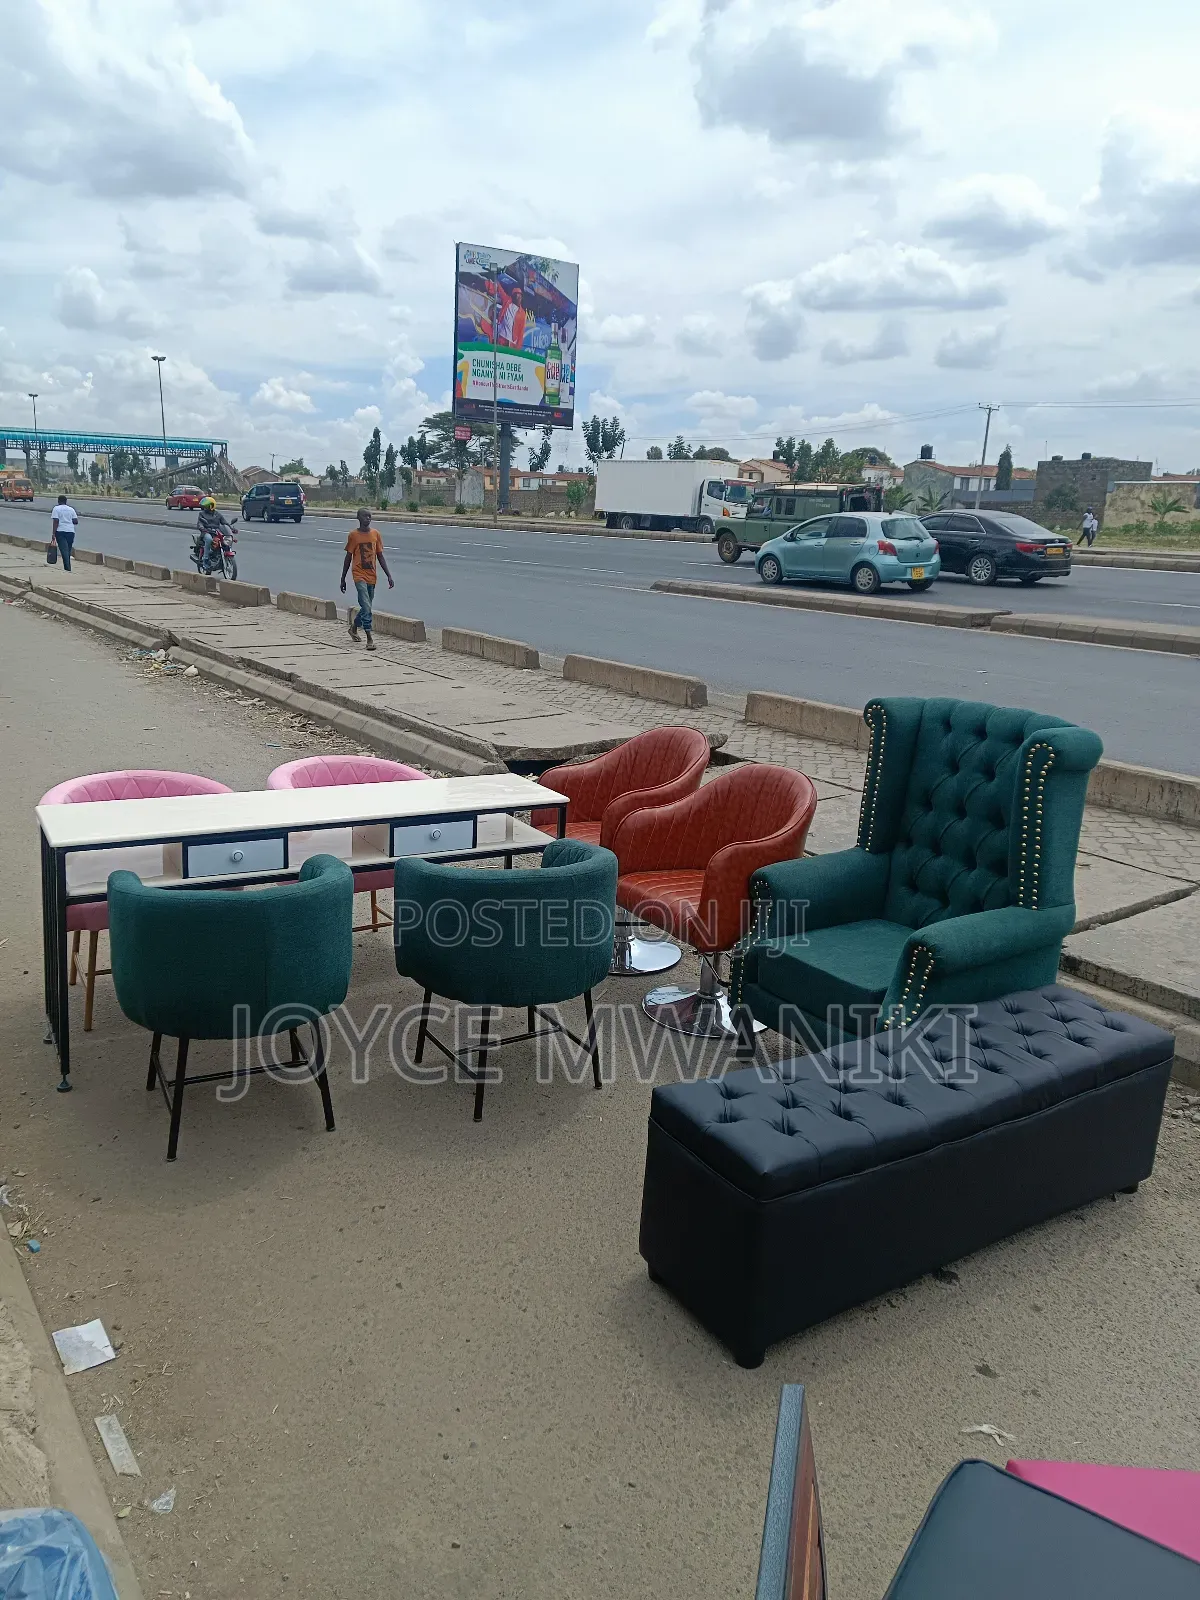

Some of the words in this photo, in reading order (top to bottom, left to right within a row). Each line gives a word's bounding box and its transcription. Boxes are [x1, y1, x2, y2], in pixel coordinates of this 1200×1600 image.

[472, 358, 505, 370] CHUNISHA
[506, 362, 522, 372] DEBE
[498, 371, 506, 380] NI
[507, 372, 524, 382] FYAM
